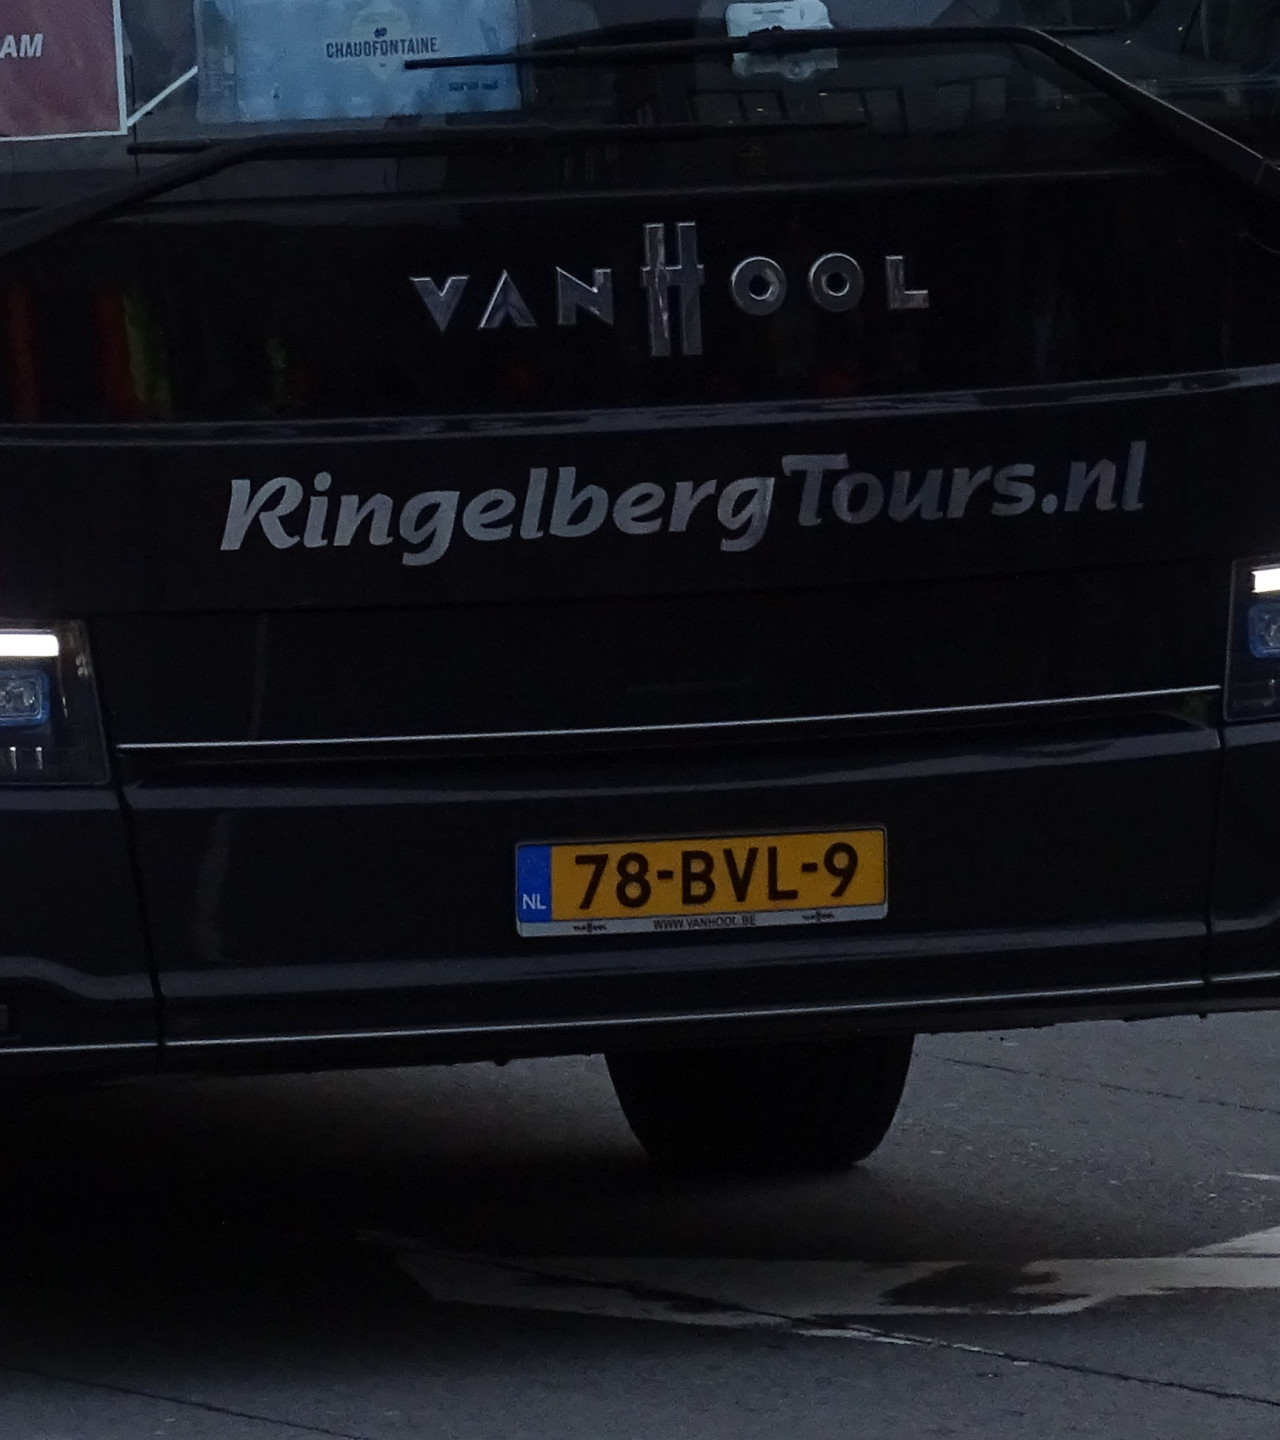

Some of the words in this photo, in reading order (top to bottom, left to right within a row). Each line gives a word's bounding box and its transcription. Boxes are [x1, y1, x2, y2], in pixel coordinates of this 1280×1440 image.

[326, 37, 438, 58] CHAUDFONTAINE
[575, 841, 858, 909] 78-BVL-9
[522, 893, 547, 910] NL
